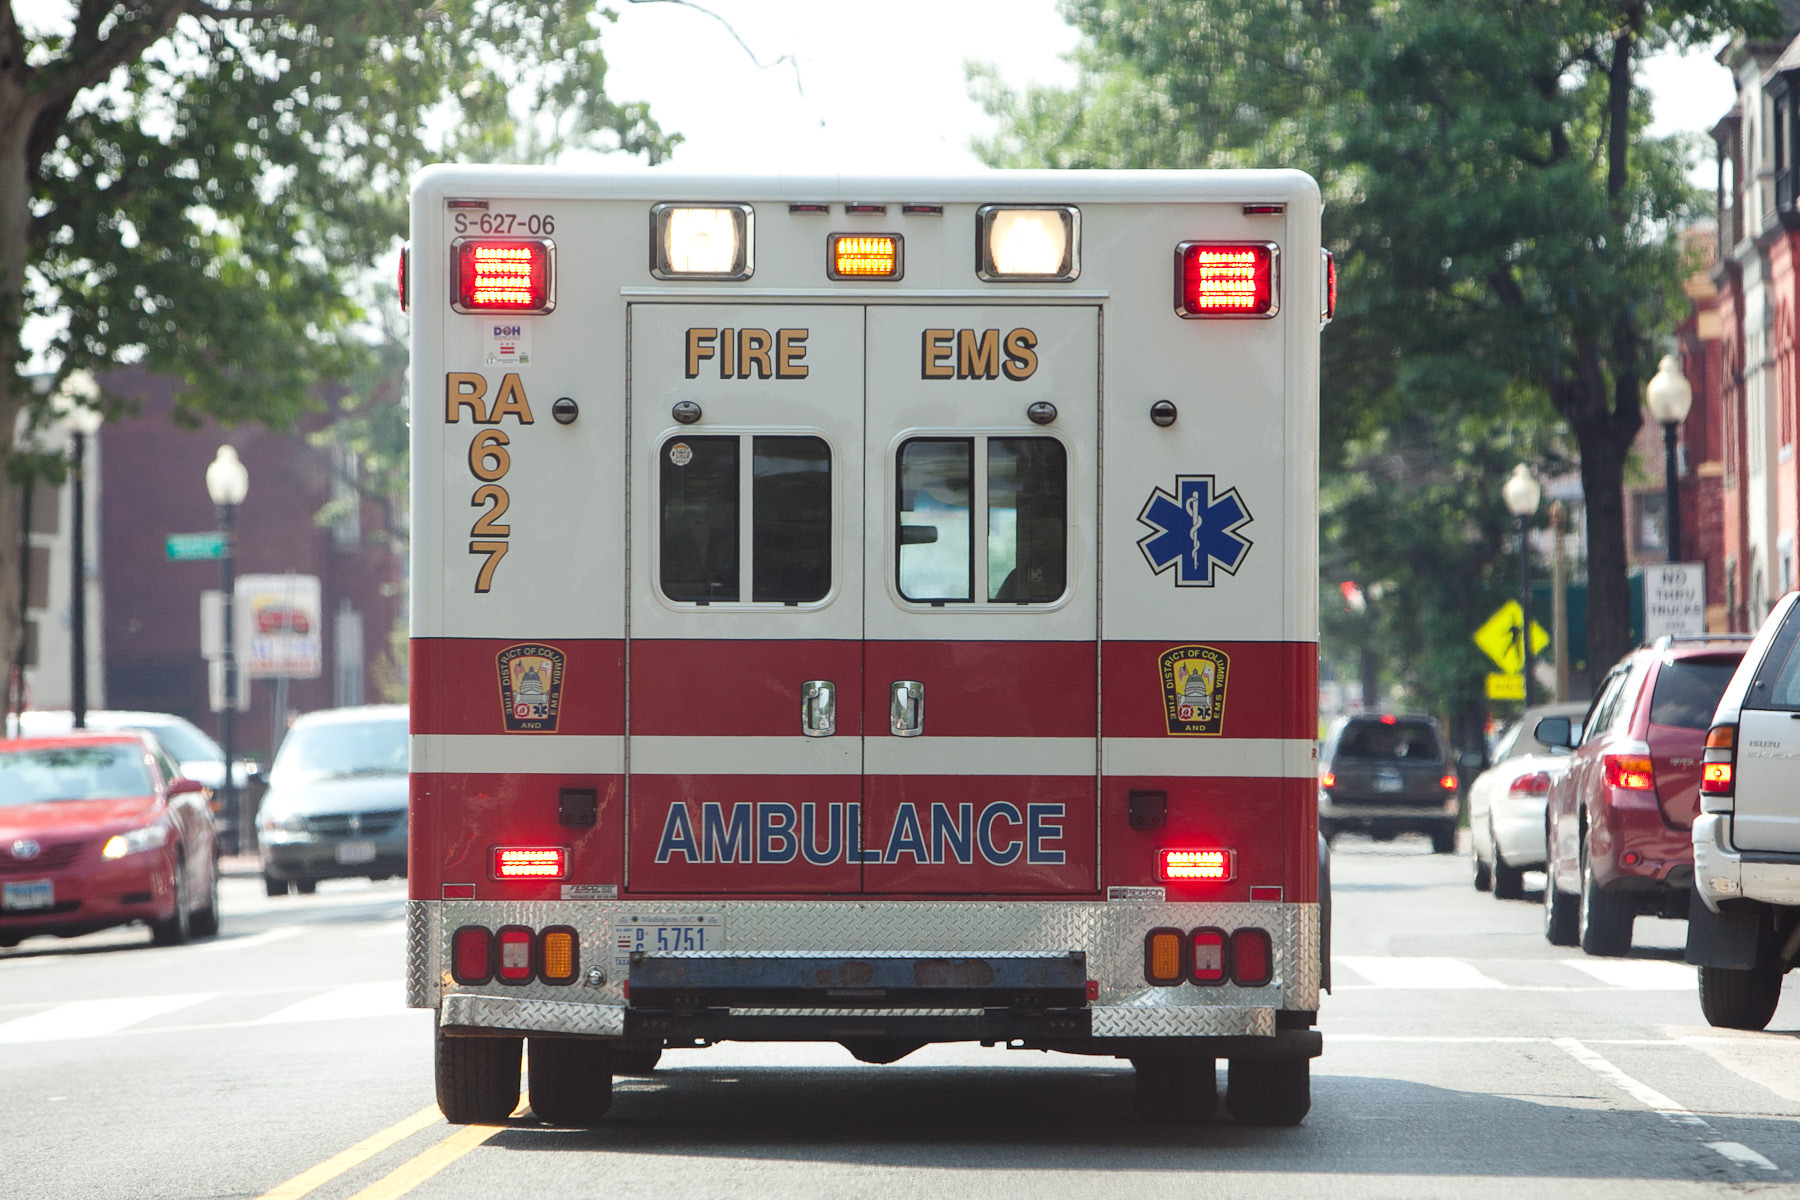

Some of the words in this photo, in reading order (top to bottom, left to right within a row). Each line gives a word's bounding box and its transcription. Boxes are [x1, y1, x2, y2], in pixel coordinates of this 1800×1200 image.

[454, 213, 555, 235] S-627-06
[494, 326, 520, 336] DOH
[685, 328, 809, 379] FIRE
[921, 328, 1038, 381] EMS
[445, 372, 534, 425] RA
[1662, 569, 1687, 585] NO
[1656, 588, 1695, 601] THRU
[1651, 604, 1701, 617] TRUCKS
[500, 648, 521, 686] DISTRICT
[524, 647, 536, 655] OF
[538, 647, 562, 685] COLUMBIA
[1164, 650, 1185, 689] DISTRICT
[1187, 650, 1200, 658] OF
[1202, 650, 1225, 688] COLUMBIA
[504, 691, 512, 715] FIRE
[550, 692, 558, 715] EMS
[1167, 695, 1177, 720] FIRE
[1213, 694, 1222, 719] EMS
[654, 801, 1066, 866] AMBULANCE
[658, 928, 704, 951] 5751
